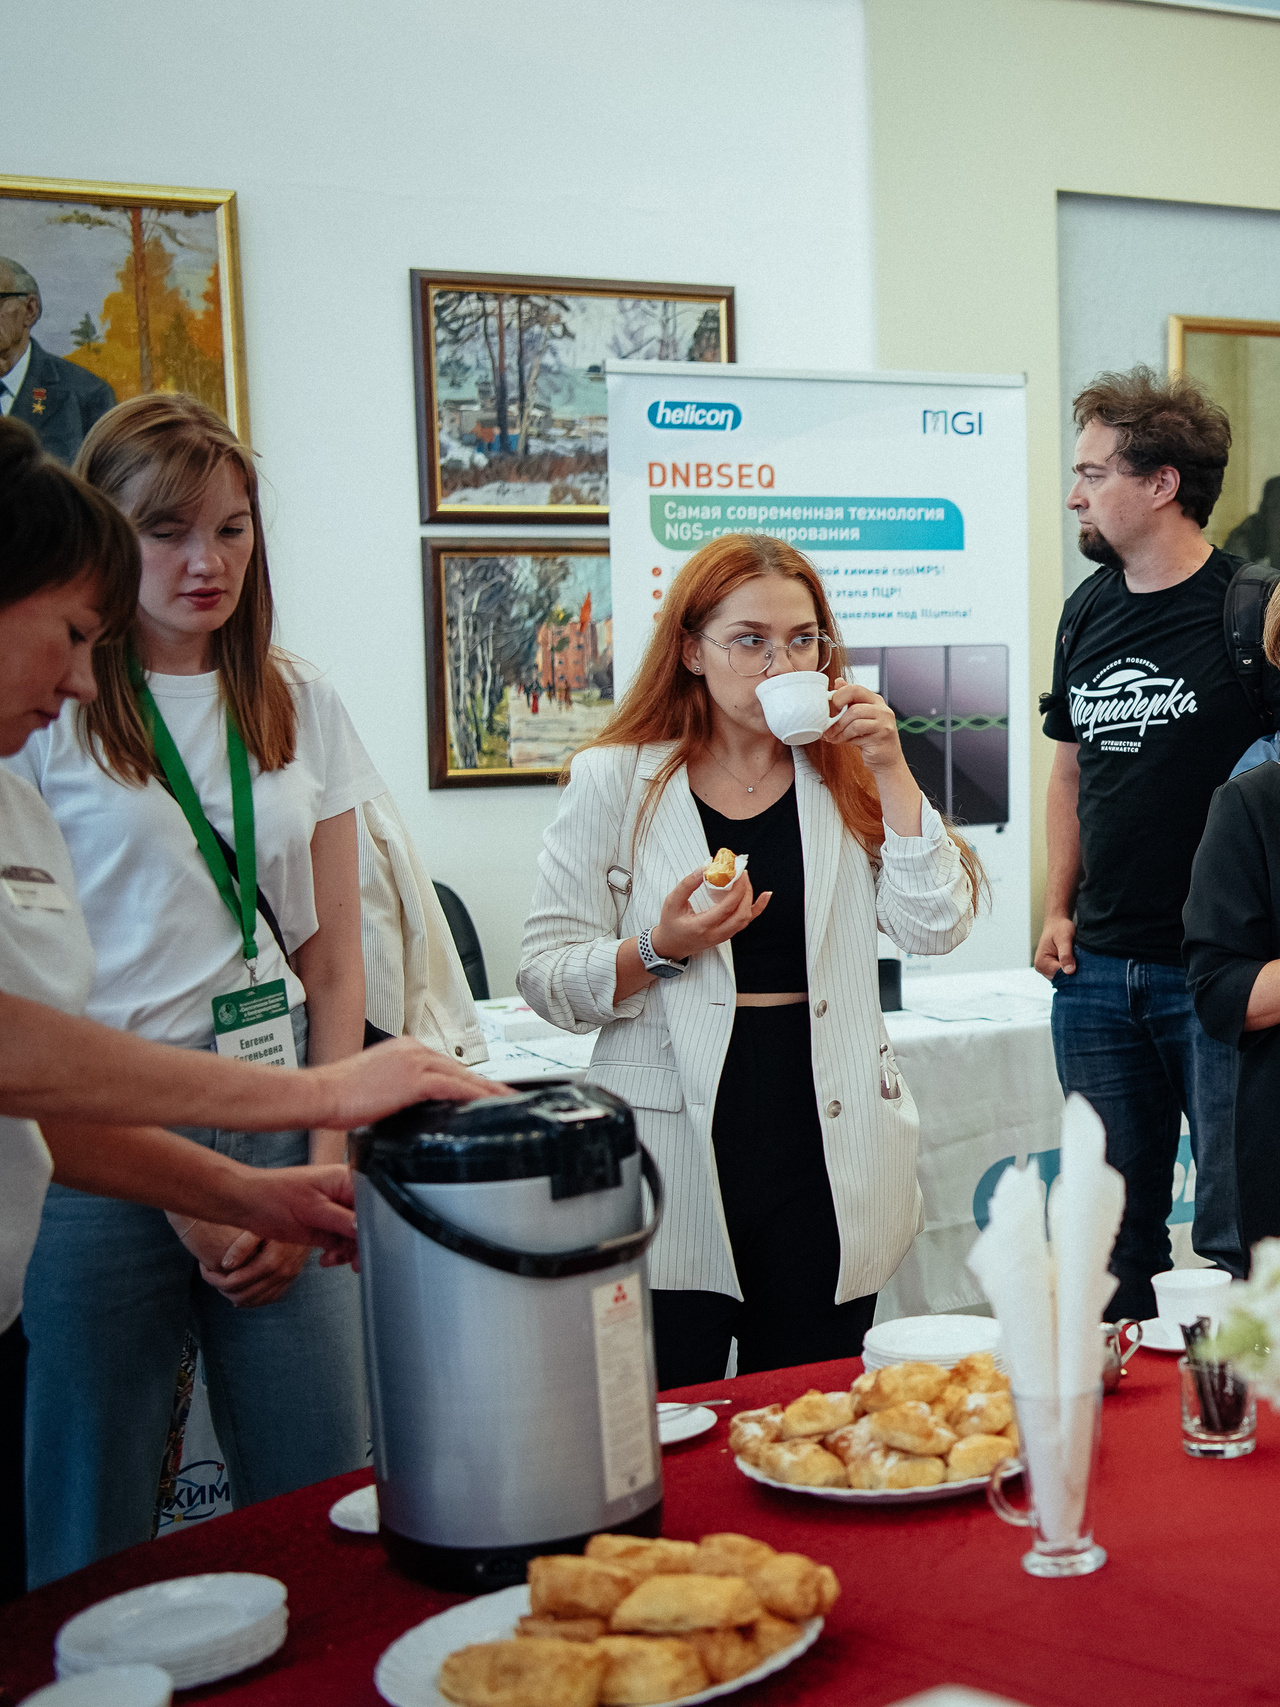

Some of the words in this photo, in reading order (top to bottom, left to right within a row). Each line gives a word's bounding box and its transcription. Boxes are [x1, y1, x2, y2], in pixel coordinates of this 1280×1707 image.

[655, 400, 734, 431] helicon
[923, 410, 982, 435] MGI
[648, 462, 775, 489] DNBSEQ
[664, 502, 721, 520] Самая
[726, 505, 844, 524] современная
[847, 505, 945, 521] технология
[234, 1044, 283, 1062] геньевна
[240, 1033, 274, 1050] Евгения
